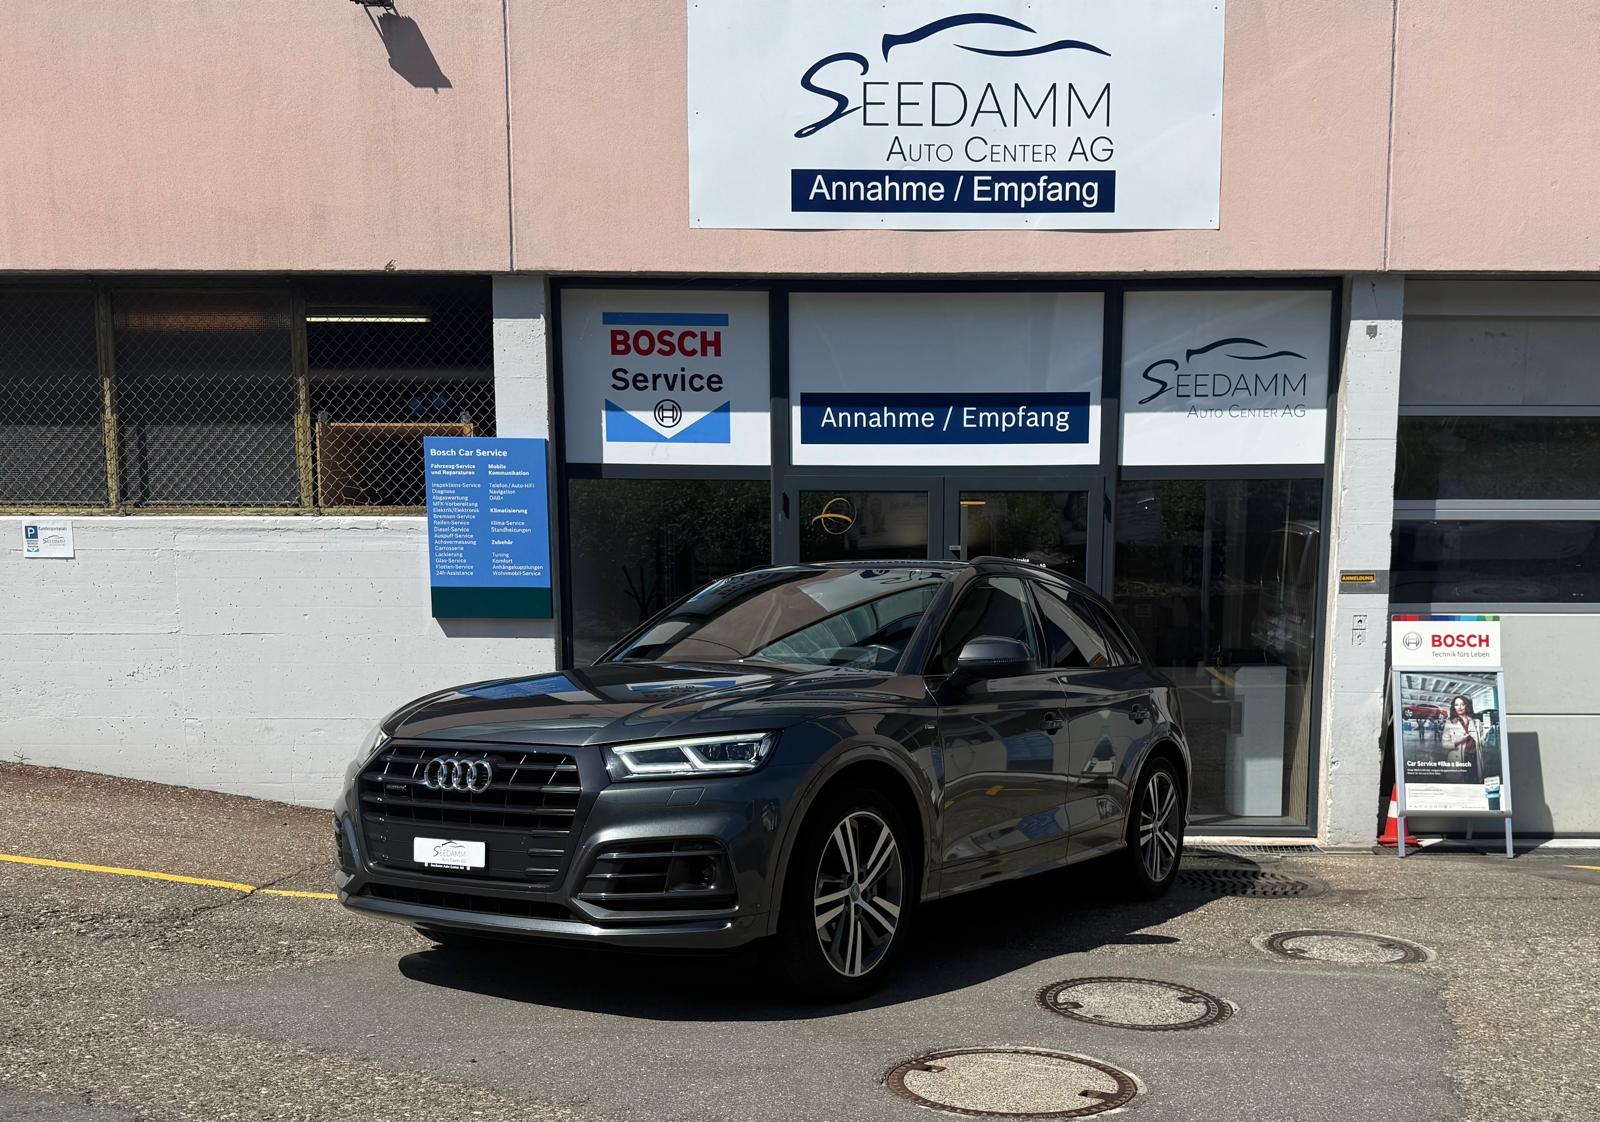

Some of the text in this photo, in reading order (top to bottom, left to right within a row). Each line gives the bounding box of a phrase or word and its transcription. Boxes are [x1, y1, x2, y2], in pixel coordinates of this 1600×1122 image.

[1068, 136, 1114, 163] AG
[809, 174, 1099, 208] Annahme / Empfang
[611, 330, 721, 357] BOSCH
[611, 367, 723, 392] Service
[821, 406, 1070, 432] Annahme / Empfang
[1281, 404, 1306, 418] AG
[27, 527, 35, 538] P
[1431, 634, 1489, 647] BOSCH
